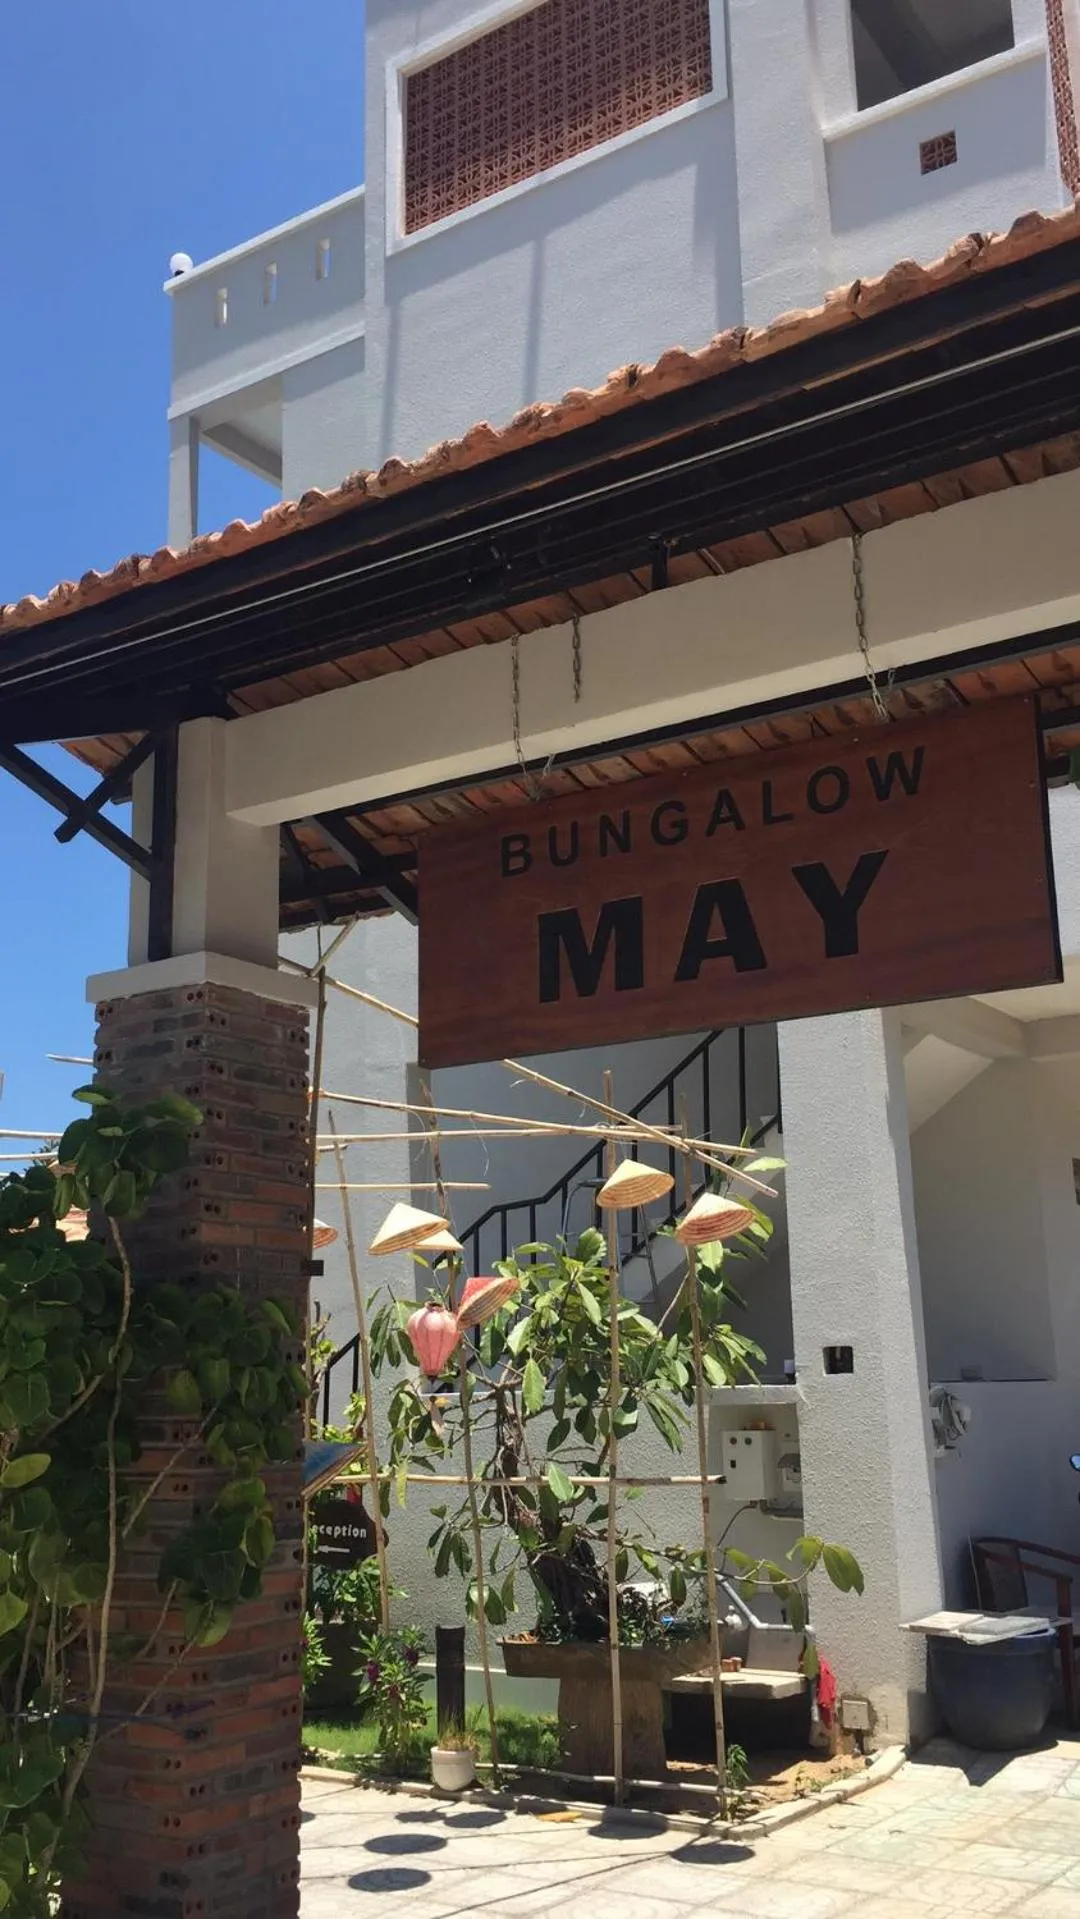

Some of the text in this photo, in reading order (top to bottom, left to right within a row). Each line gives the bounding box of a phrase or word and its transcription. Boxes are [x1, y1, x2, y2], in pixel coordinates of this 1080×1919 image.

[501, 746, 925, 876] BUNGALOW
[538, 850, 889, 1003] MAY
[311, 1524, 367, 1539] eception
